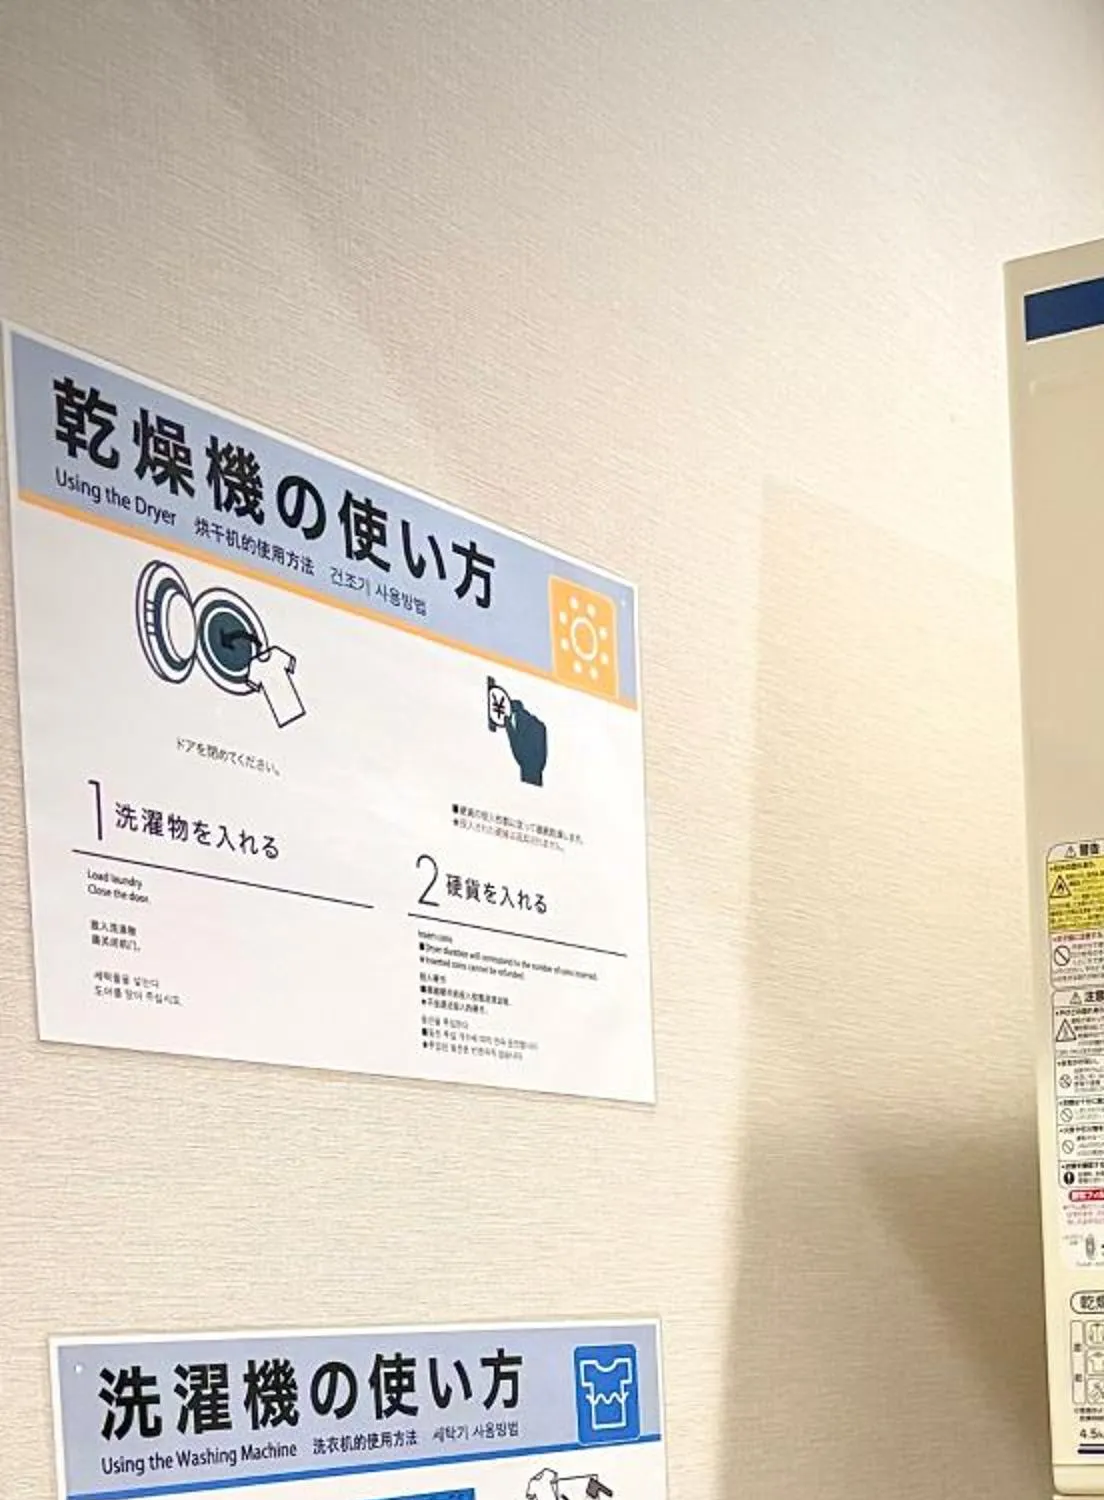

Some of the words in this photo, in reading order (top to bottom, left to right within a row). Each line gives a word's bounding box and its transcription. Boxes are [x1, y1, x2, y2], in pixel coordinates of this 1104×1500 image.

[52, 377, 496, 609] 乾燥機の使い方
[55, 468, 101, 502] Using
[105, 485, 132, 509] the
[135, 496, 177, 527] Dryer
[194, 516, 315, 576] 烘干机的使用方法
[330, 566, 370, 594] 건조기
[115, 801, 279, 859] 洗濯物を入れる
[87, 884, 113, 897] Close
[416, 853, 440, 907] 2
[446, 873, 548, 915] 硬貨を入れる
[99, 1347, 523, 1442] 洗濯機の使い方
[101, 1454, 145, 1476] Using
[148, 1451, 173, 1471] the
[175, 1446, 239, 1469] Washing
[240, 1441, 298, 1462] Machine
[312, 1429, 418, 1455] 洗衣机的使用方法
